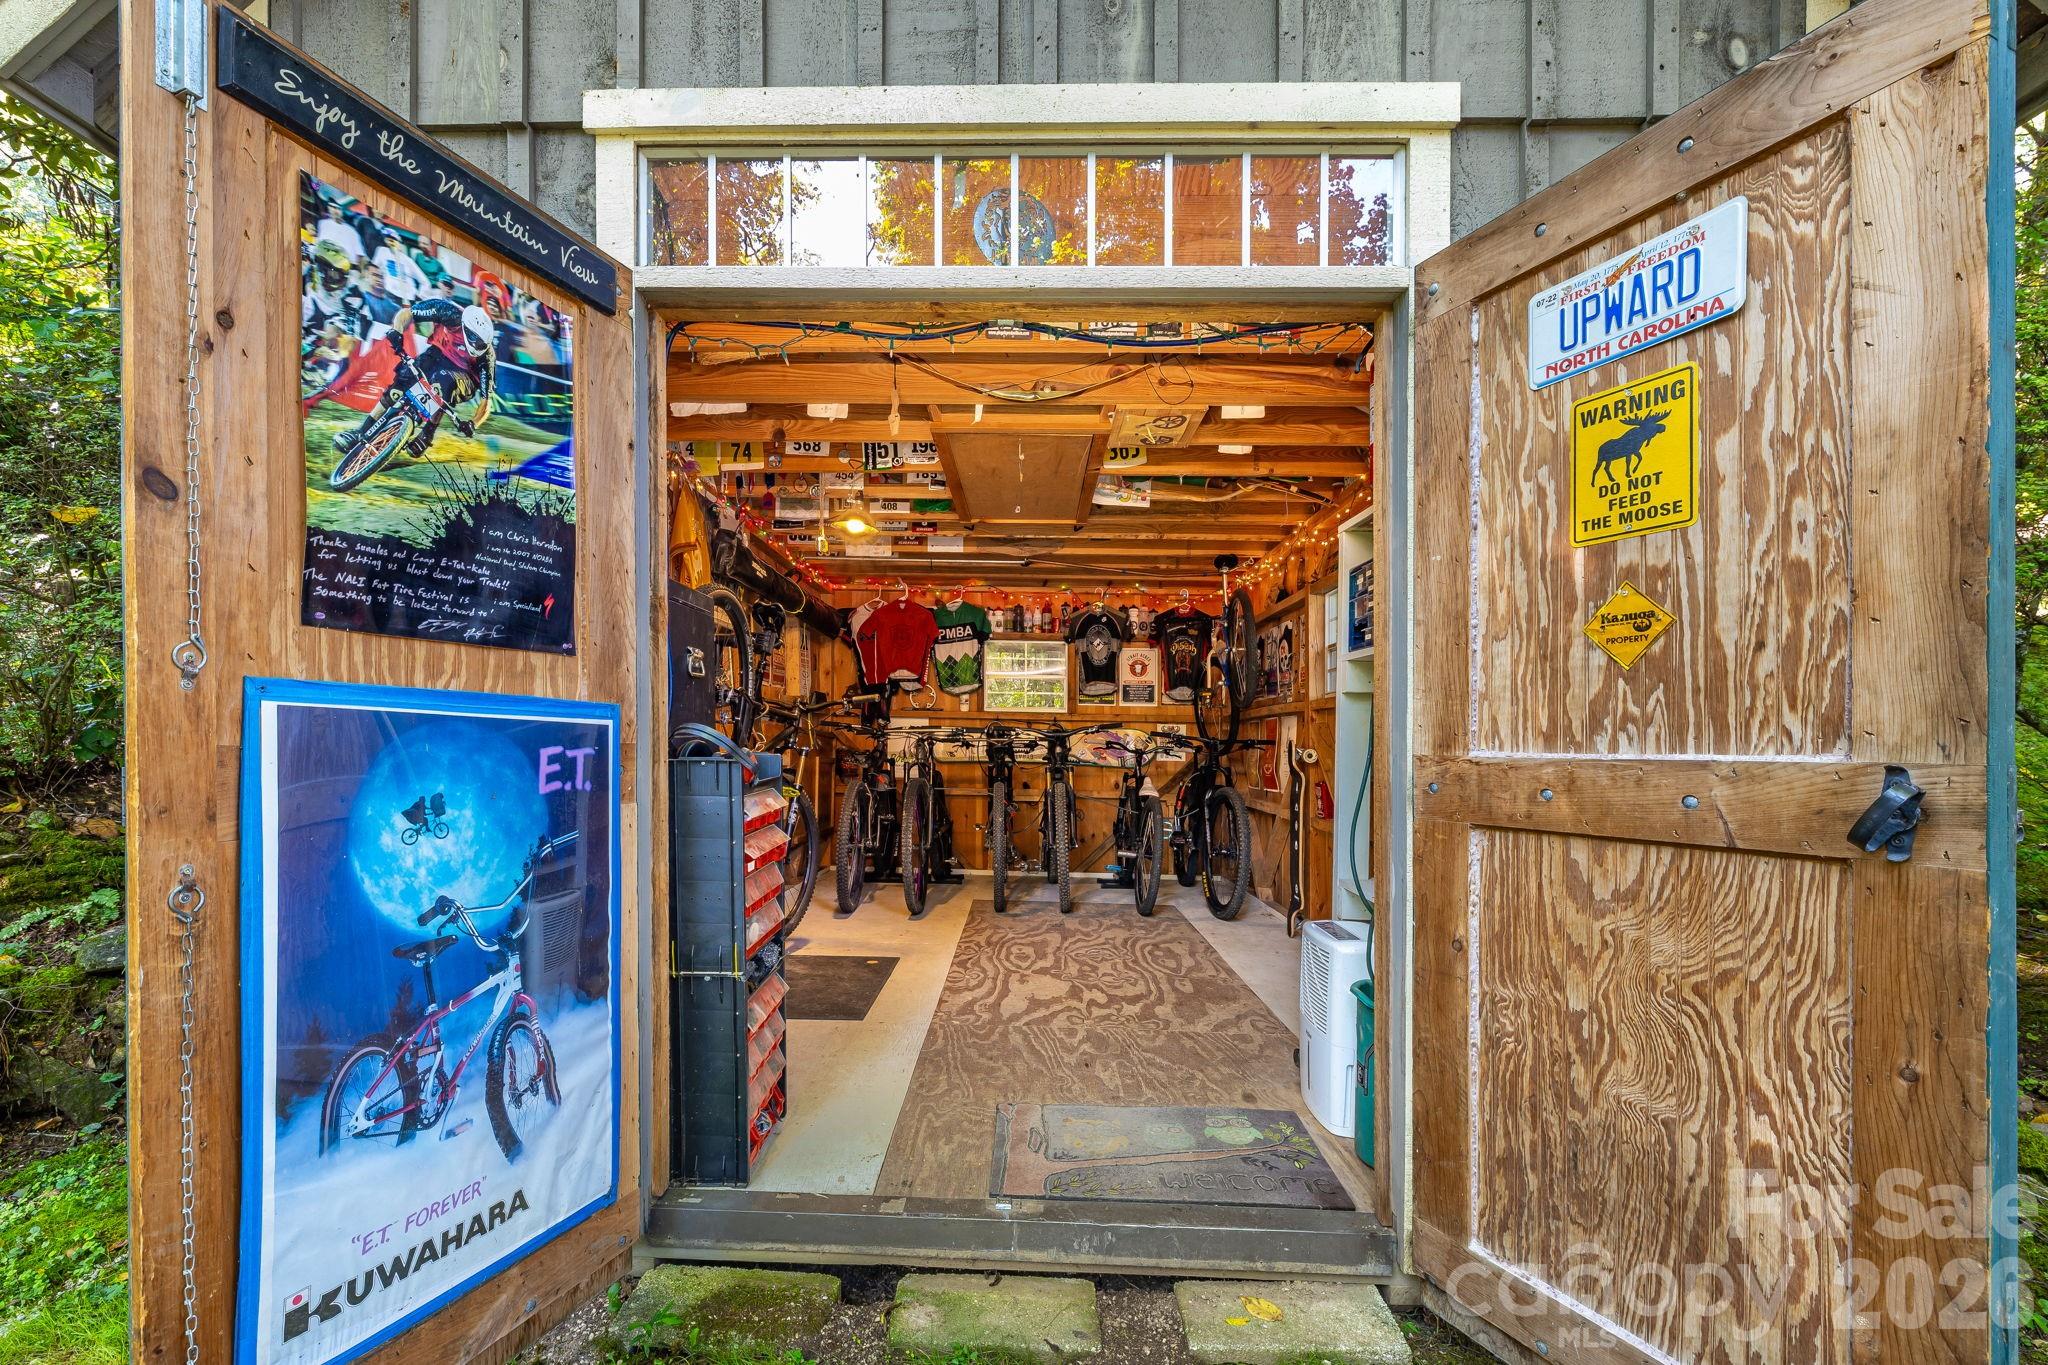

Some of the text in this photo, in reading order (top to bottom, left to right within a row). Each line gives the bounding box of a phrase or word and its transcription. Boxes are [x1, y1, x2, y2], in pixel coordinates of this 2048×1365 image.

[274, 69, 599, 285] Enjoy the Mountain View
[1560, 281, 1601, 306] FIRST
[1627, 231, 1706, 276] FREEDOM
[1536, 293, 1557, 307] 07-22
[1573, 278, 1588, 291] May
[1560, 247, 1700, 352] UPWARD
[1545, 297, 1725, 379] NORTH CAROLINA
[1580, 379, 1686, 428] WARNING
[731, 443, 752, 462] 74
[1598, 471, 1663, 499] DO NOT
[881, 503, 898, 511] 408
[1608, 491, 1651, 511] FEED
[1582, 500, 1683, 532] THE MOOSE
[310, 535, 348, 548] Thanks
[393, 550, 406, 558] and
[489, 531, 503, 539] am
[507, 531, 529, 544] Chris
[532, 536, 562, 552] Herndon
[317, 548, 337, 559] for
[345, 552, 381, 570] letting
[406, 563, 428, 575] blast
[433, 568, 452, 580] down
[458, 576, 475, 586] your
[475, 553, 501, 564] National
[304, 568, 327, 580] The
[372, 579, 389, 590] Fat
[393, 583, 414, 596] Tire
[418, 588, 453, 601] Festival
[393, 595, 405, 606] be
[411, 599, 438, 610] looked
[442, 605, 475, 616] forward
[1601, 610, 1656, 625] Kanuga
[939, 625, 973, 639] PMBA
[1606, 634, 1649, 645] PROPERTY
[538, 745, 595, 795] E.T.
[282, 1187, 530, 1345] KUWAHARA
